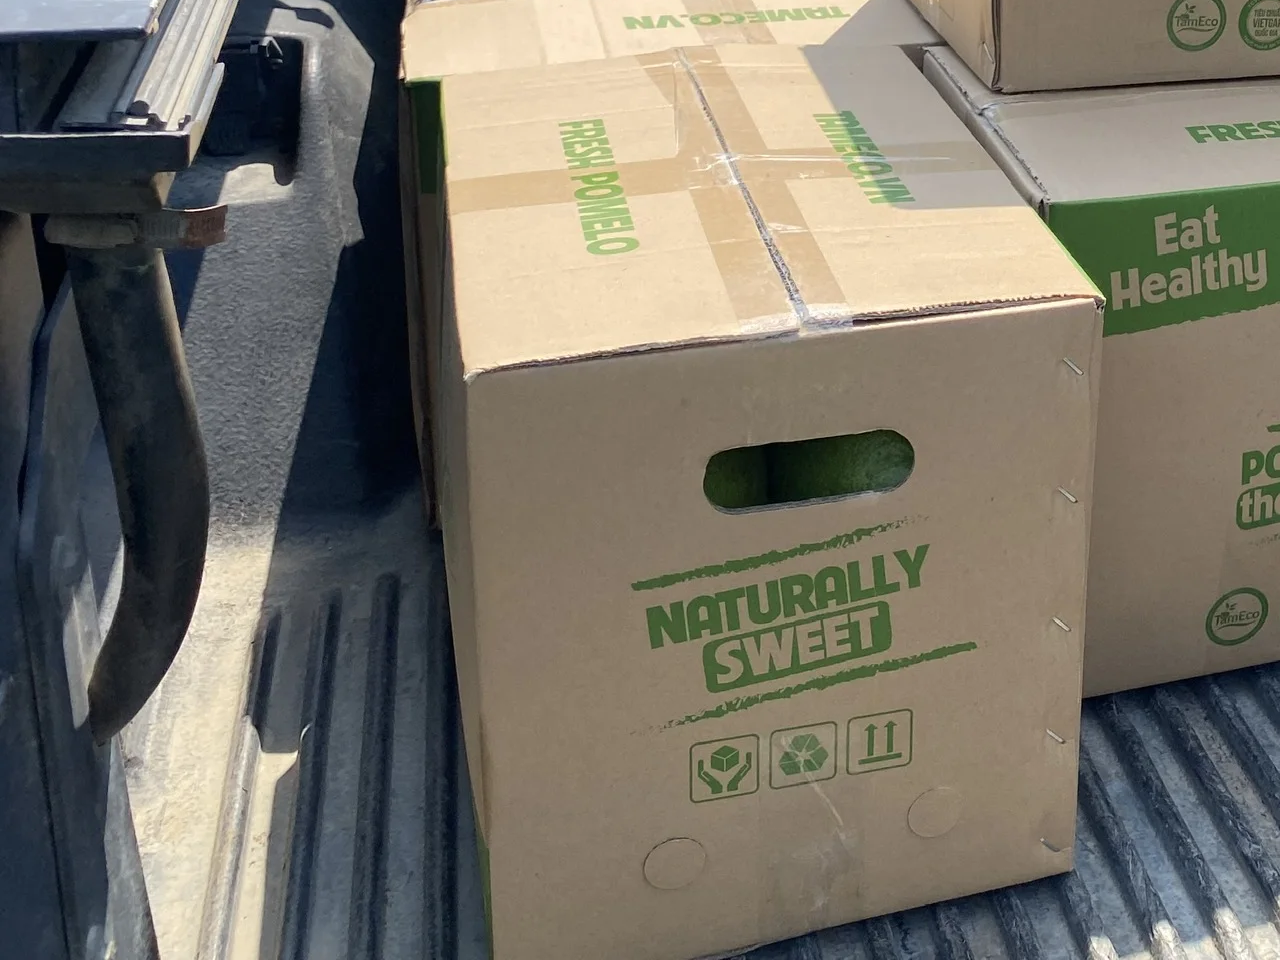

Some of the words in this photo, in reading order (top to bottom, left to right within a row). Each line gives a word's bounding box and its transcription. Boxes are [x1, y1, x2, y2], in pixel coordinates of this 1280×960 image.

[622, 5, 852, 30] TAMECO.VN
[1174, 15, 1219, 27] TamEco
[558, 118, 617, 171] FRESH
[812, 110, 916, 205] TAMECO.VN
[570, 170, 640, 256] POMELO
[1154, 204, 1221, 257] Eat
[1110, 248, 1268, 311] Healthy
[645, 543, 931, 650] NATURALLY
[714, 605, 880, 685] SWEET
